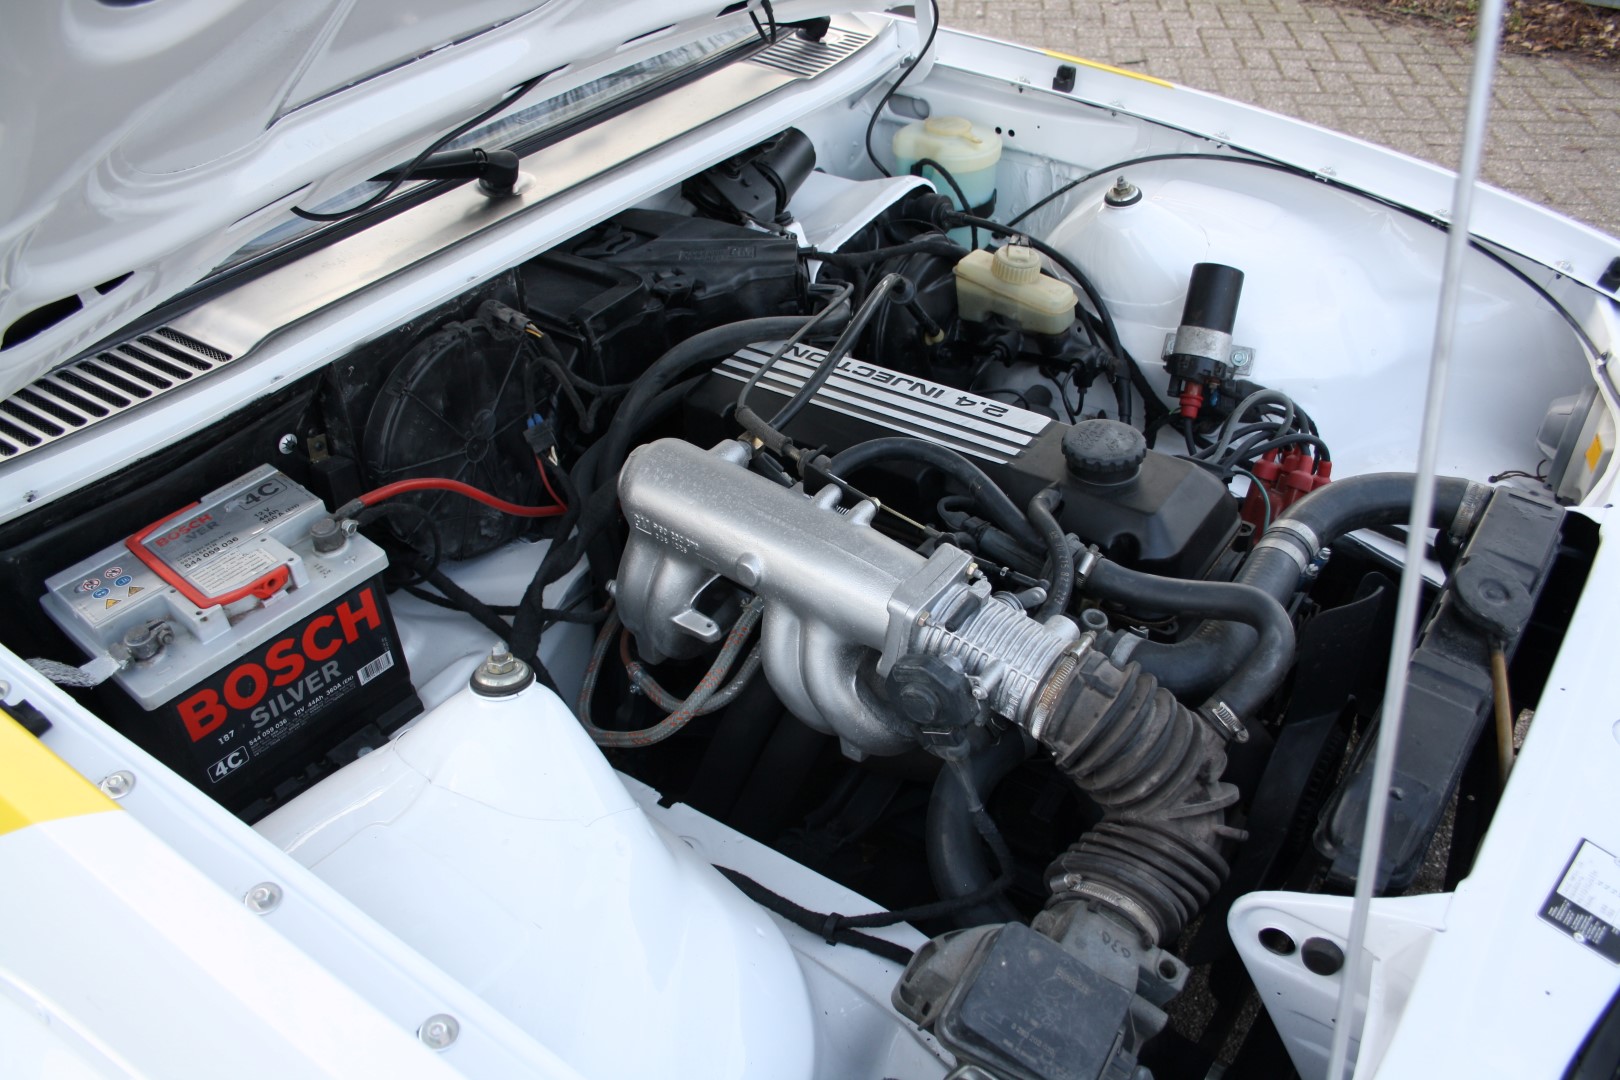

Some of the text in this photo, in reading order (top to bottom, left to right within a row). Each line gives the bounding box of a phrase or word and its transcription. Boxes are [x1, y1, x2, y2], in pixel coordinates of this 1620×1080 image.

[790, 345, 1009, 418] 2.4 INJECTON
[245, 482, 280, 505] 4C
[155, 513, 214, 548] BOSCH
[184, 557, 202, 569] 544
[203, 547, 221, 559] 059
[221, 536, 239, 548] 036
[176, 587, 382, 743] BOSCH
[250, 660, 342, 729] SILVER
[248, 735, 261, 746] 544
[262, 727, 274, 738] 059
[275, 718, 288, 729] 036
[293, 706, 305, 717] 12V
[307, 695, 324, 708] 44Ah
[326, 683, 342, 696] 360A
[218, 729, 235, 745] 187
[215, 752, 243, 777] 4C
